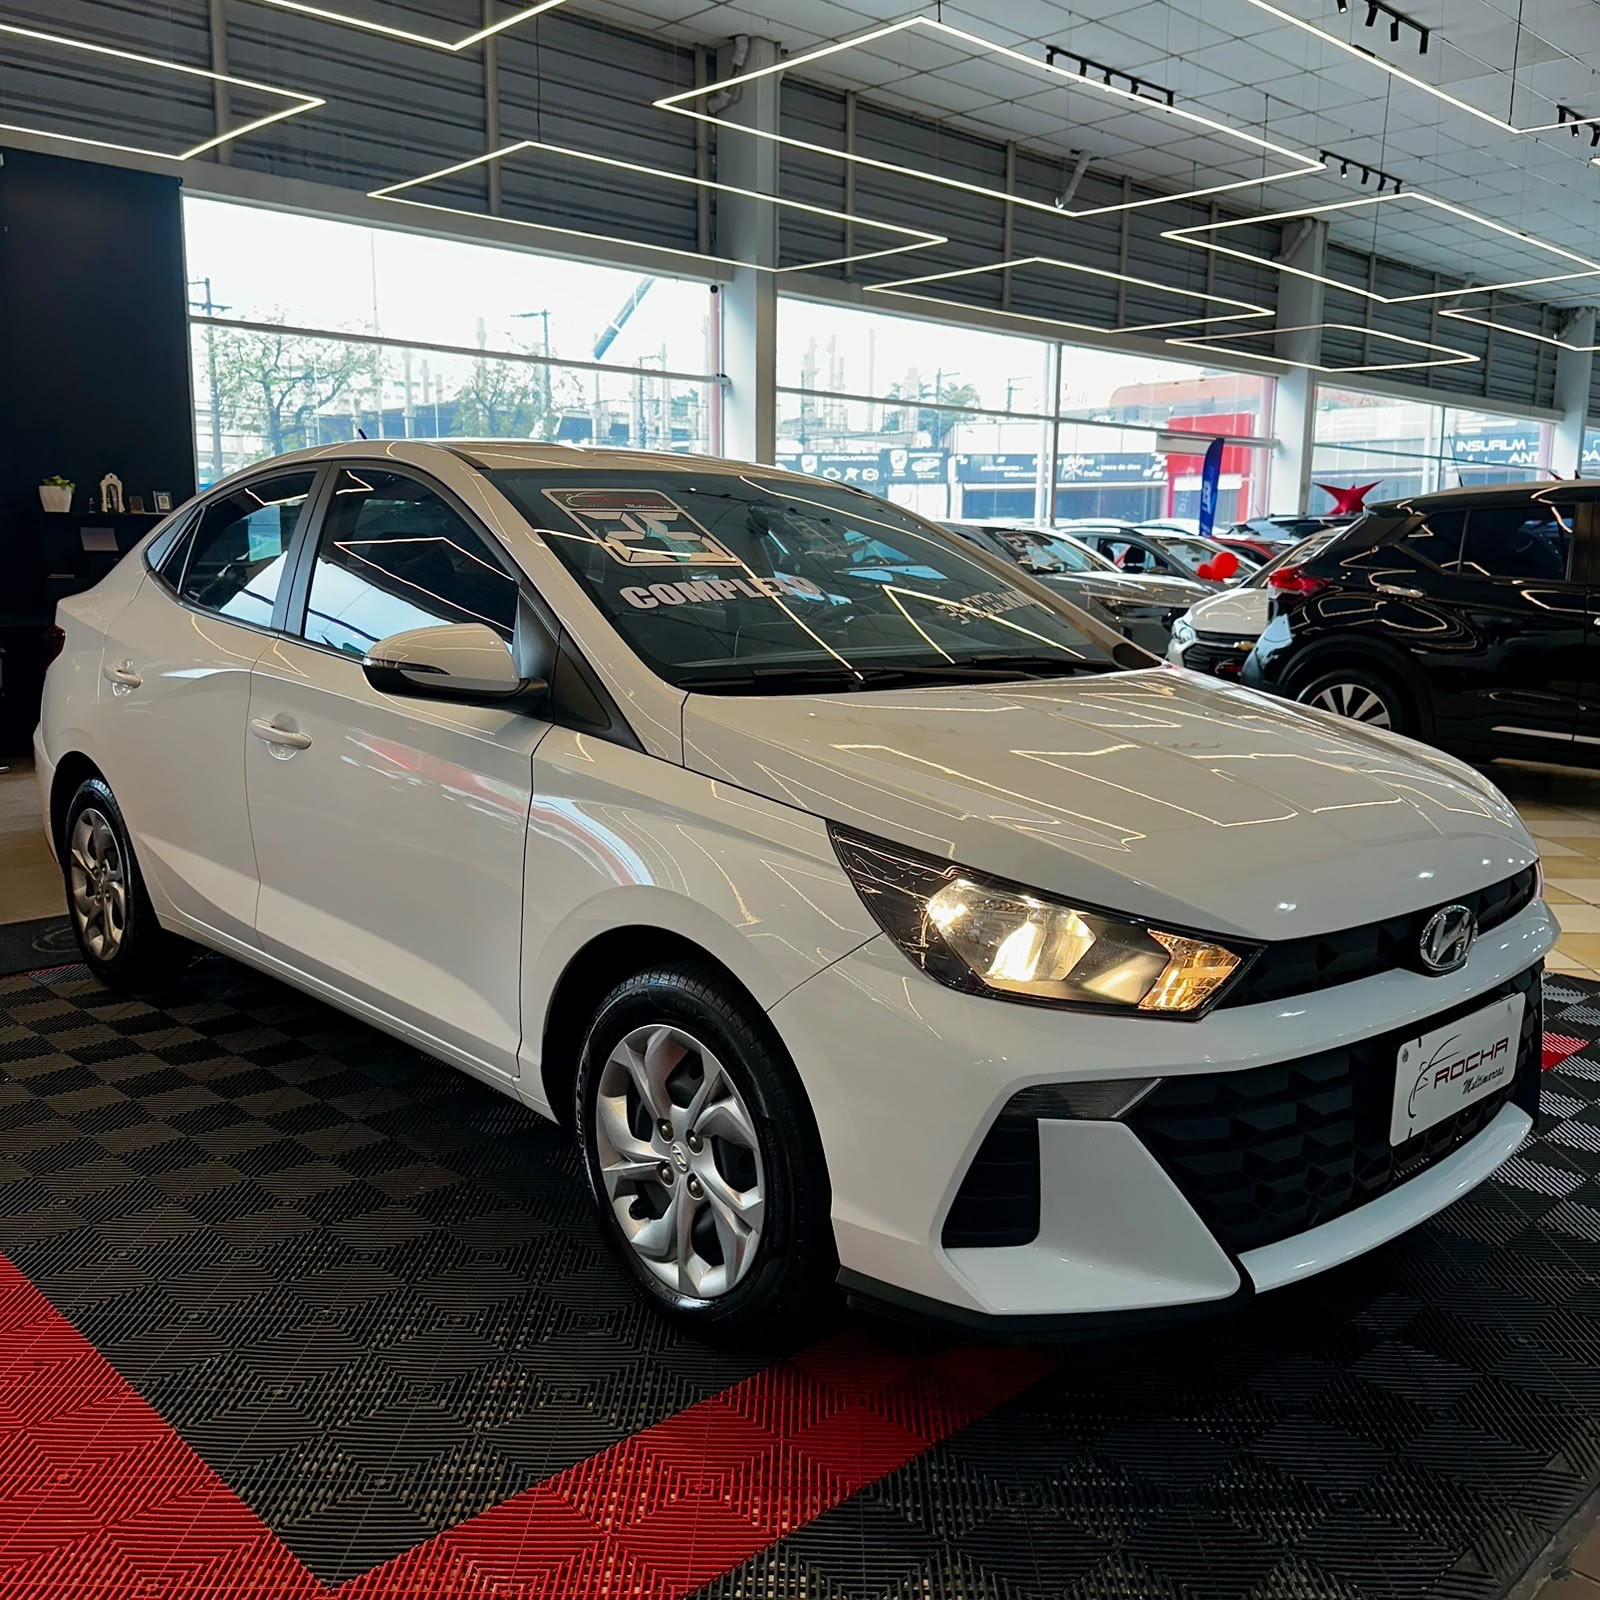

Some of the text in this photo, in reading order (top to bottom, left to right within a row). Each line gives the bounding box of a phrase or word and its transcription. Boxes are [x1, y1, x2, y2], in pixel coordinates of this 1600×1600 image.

[1456, 439, 1527, 452] INSUFILM
[620, 577, 822, 609] COMPLETO
[1433, 1037, 1509, 1090] ROCHA
